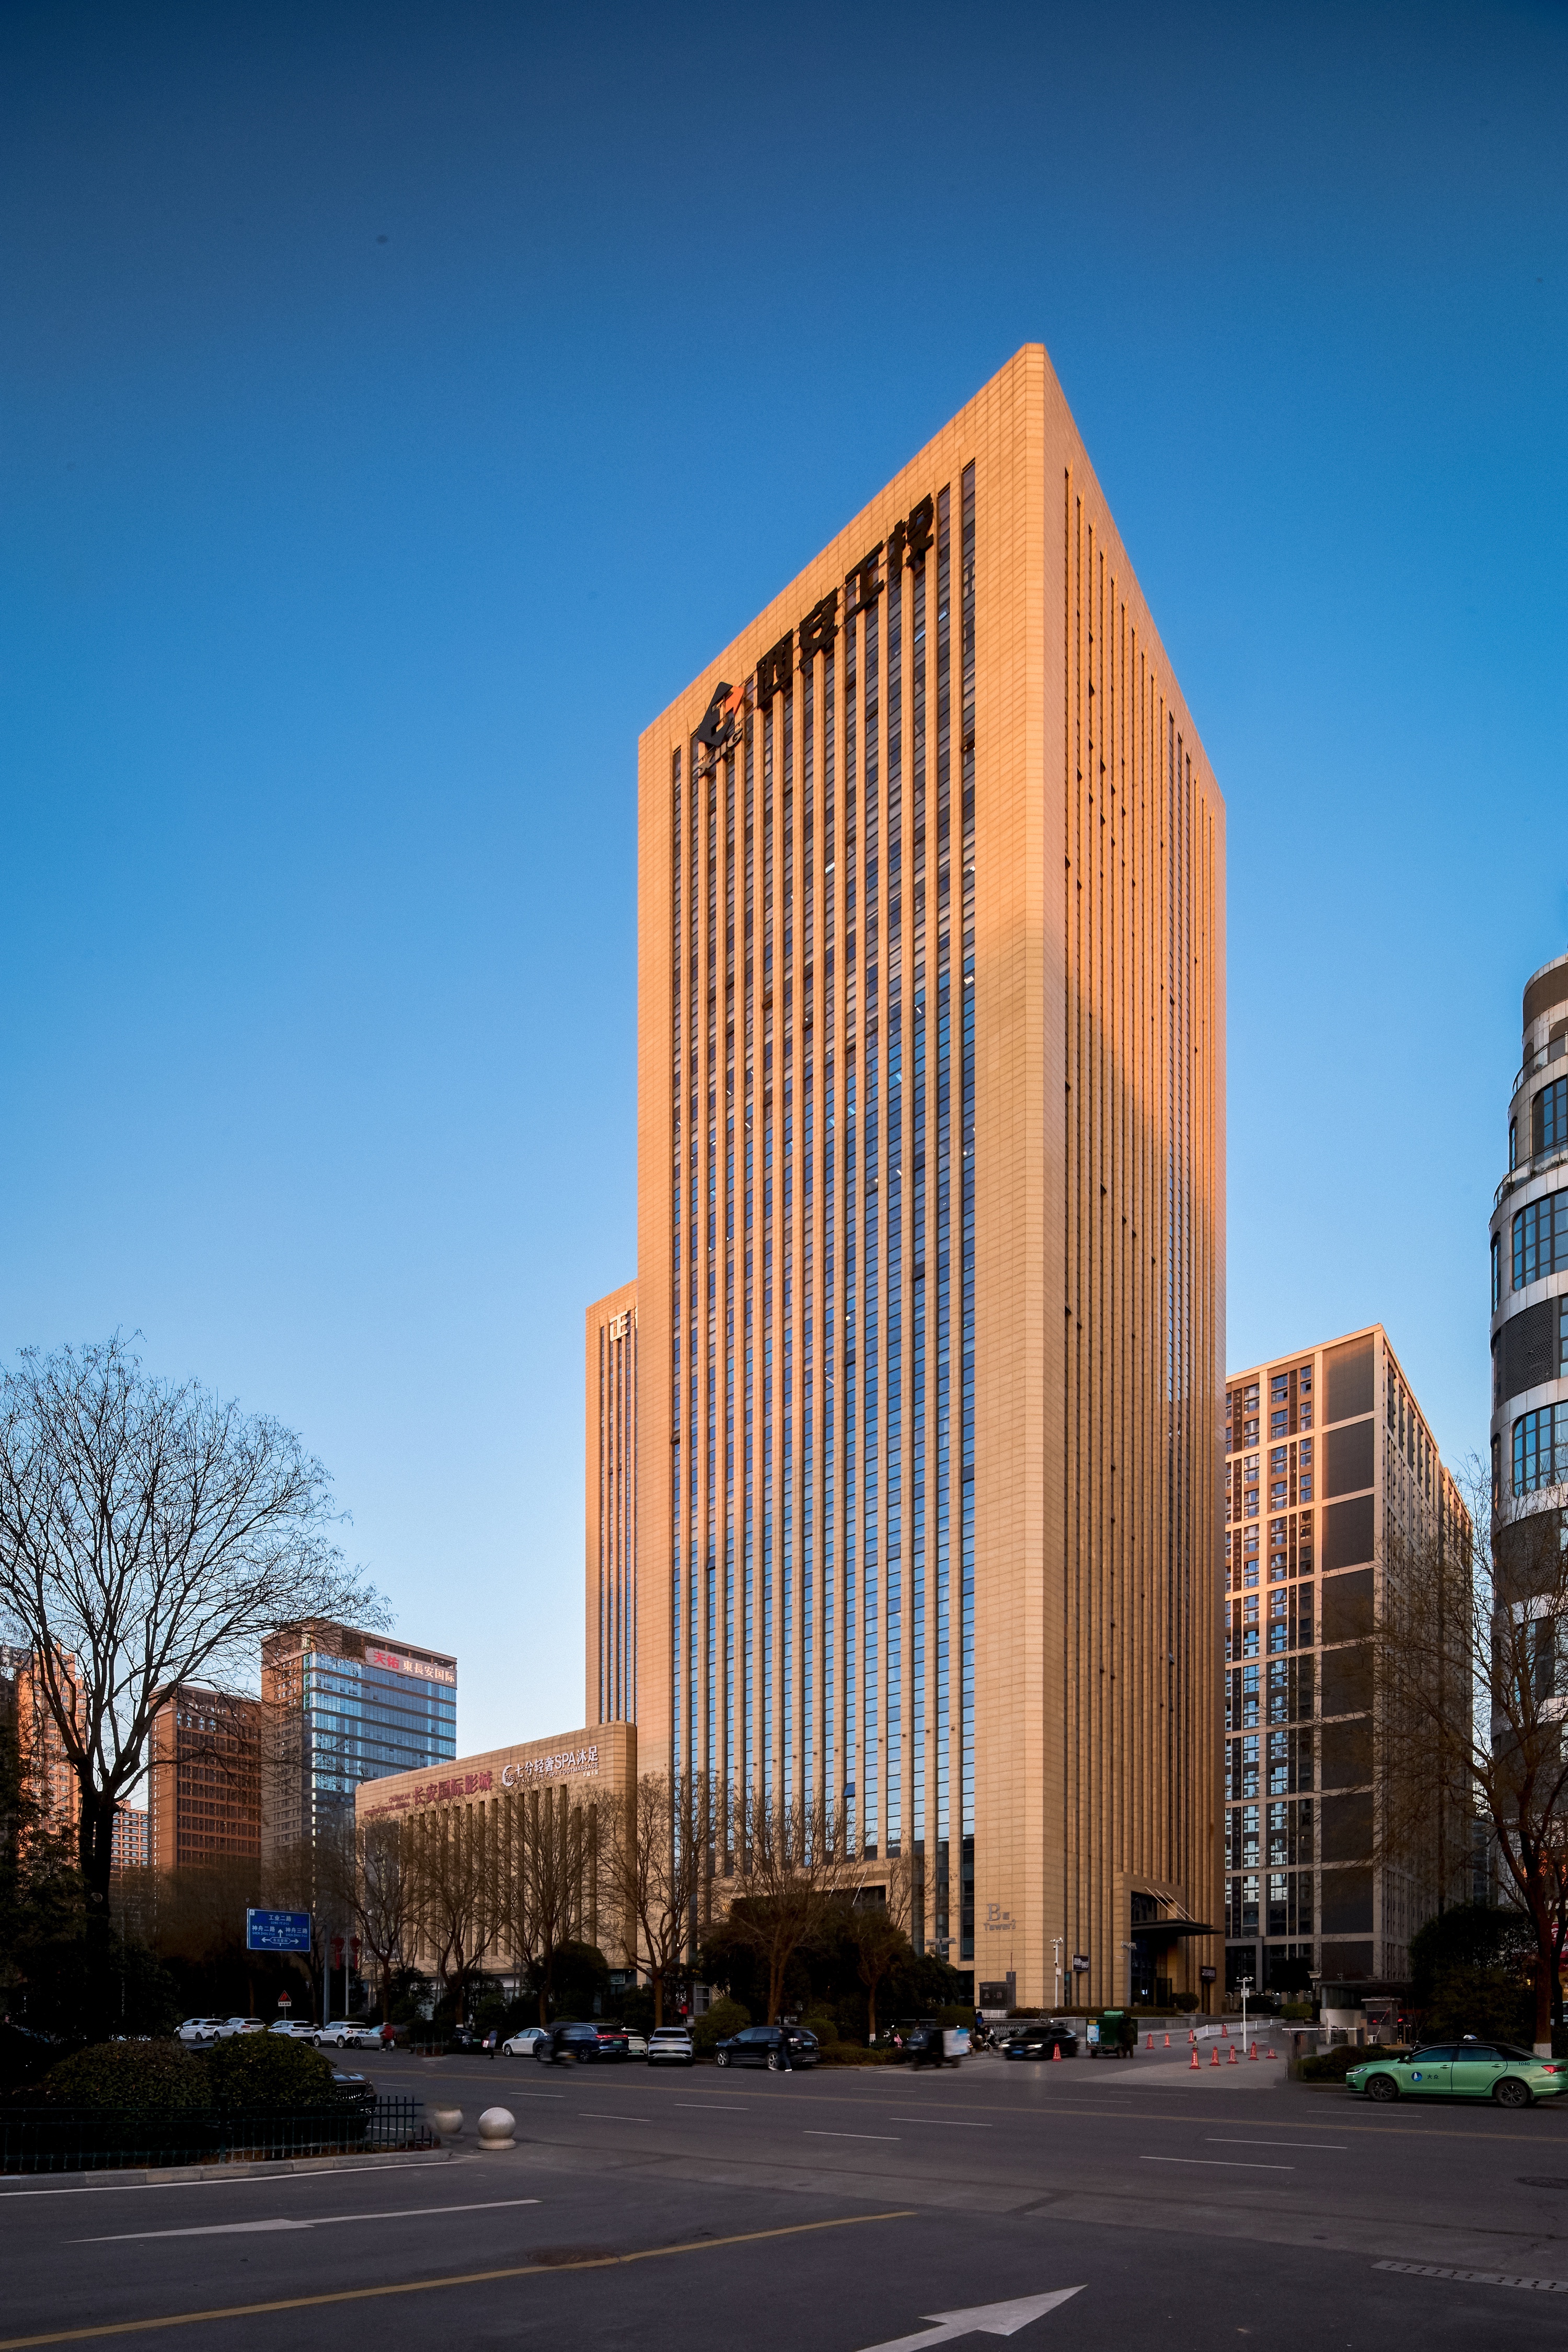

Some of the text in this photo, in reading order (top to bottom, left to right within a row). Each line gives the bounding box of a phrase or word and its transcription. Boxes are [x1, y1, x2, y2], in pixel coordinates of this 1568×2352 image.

[756, 493, 934, 709] 西安工投
[560, 1762, 599, 1775] FOOTMASSAGE
[413, 1770, 492, 1805] 长安国际影城
